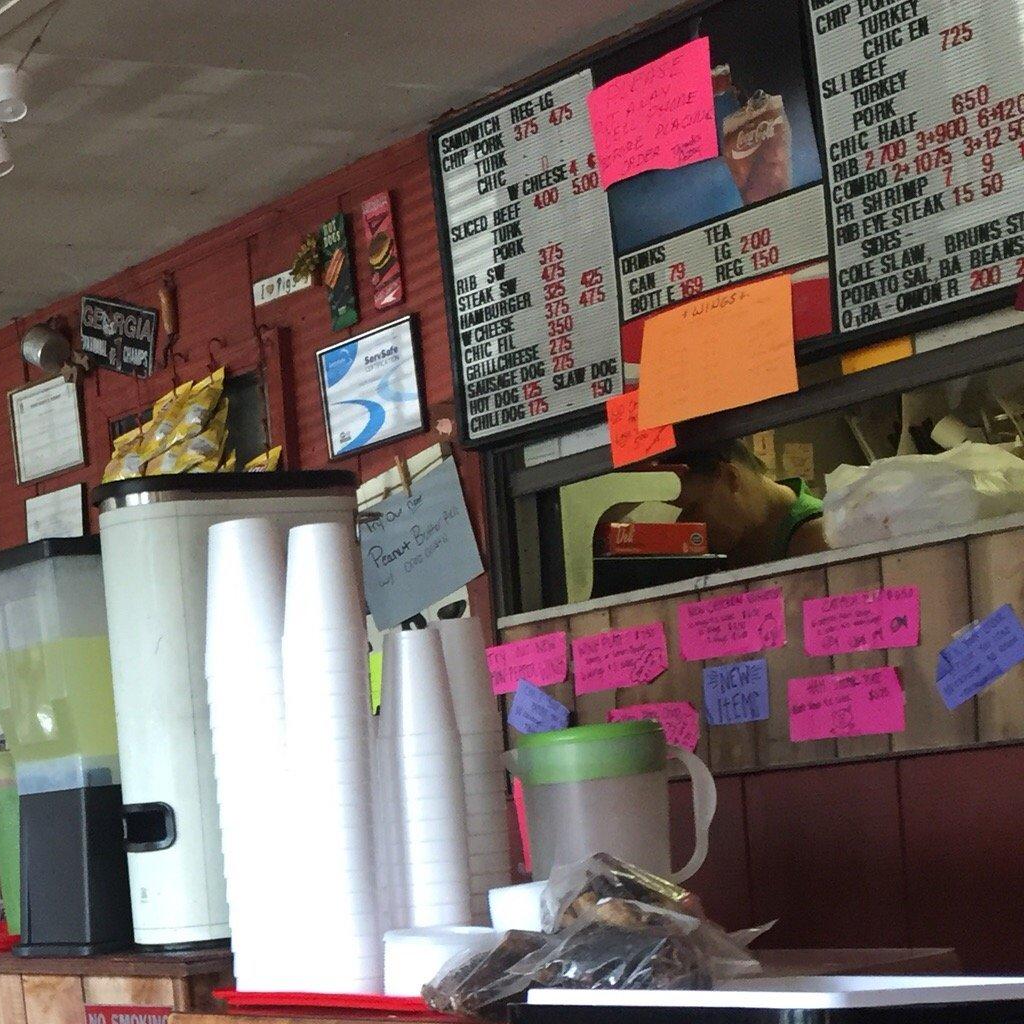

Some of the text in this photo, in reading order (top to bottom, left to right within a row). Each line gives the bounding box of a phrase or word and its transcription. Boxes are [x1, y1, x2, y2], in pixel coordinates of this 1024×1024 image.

[816, 4, 851, 35] CHIP
[858, 0, 919, 38] TURKEY
[939, 20, 973, 51] 725
[850, 56, 887, 88] BEEF
[851, 69, 908, 109] TURKEY
[829, 84, 989, 162] CHIC HALF 650
[853, 97, 896, 131] PORK
[441, 116, 501, 155] SANDWICH
[443, 149, 468, 172] CHIP
[474, 133, 505, 159] PORK
[514, 118, 539, 142] 375
[549, 103, 573, 126] 475
[475, 151, 508, 177] TURK
[522, 164, 568, 196] CHEESE
[832, 157, 859, 183] RIB
[477, 171, 507, 195] CHIC
[533, 187, 559, 209] 400
[833, 169, 887, 204] COMBO
[836, 204, 854, 225] FR
[863, 176, 928, 215] SHRIMP
[982, 153, 993, 173] 9
[451, 201, 521, 243] SLICED BEEF
[491, 221, 523, 245] TURK
[704, 223, 731, 246] TEA
[836, 223, 860, 246] RIB
[862, 212, 890, 237] EYE
[892, 192, 946, 227] STEAK
[493, 239, 526, 263] PORK
[622, 228, 771, 275] DRINKS LG 200
[838, 259, 878, 288] COLE
[945, 219, 1002, 254] BRUNS
[861, 230, 901, 258] SIDES
[457, 243, 563, 296] RIB SW 375
[459, 287, 494, 312] STEAK
[541, 262, 565, 282] 475
[629, 272, 656, 295] CAN
[716, 260, 743, 283] REG
[750, 246, 779, 270] 150
[841, 275, 899, 308] POTATO
[970, 236, 1024, 269] BEANS
[460, 291, 532, 330] HAMBURGER
[476, 316, 515, 341] CHEESE
[545, 298, 569, 319] 375
[579, 286, 605, 307] 475
[365, 345, 398, 365] ServSafe
[465, 343, 492, 364] CHIC
[548, 316, 573, 337] 350
[550, 335, 572, 356] 275
[470, 396, 491, 415] HOT
[495, 389, 519, 408] DOG
[552, 369, 585, 391] SLAW
[591, 358, 617, 378] DOG
[521, 361, 545, 382] DOG
[368, 541, 410, 569] Peanut
